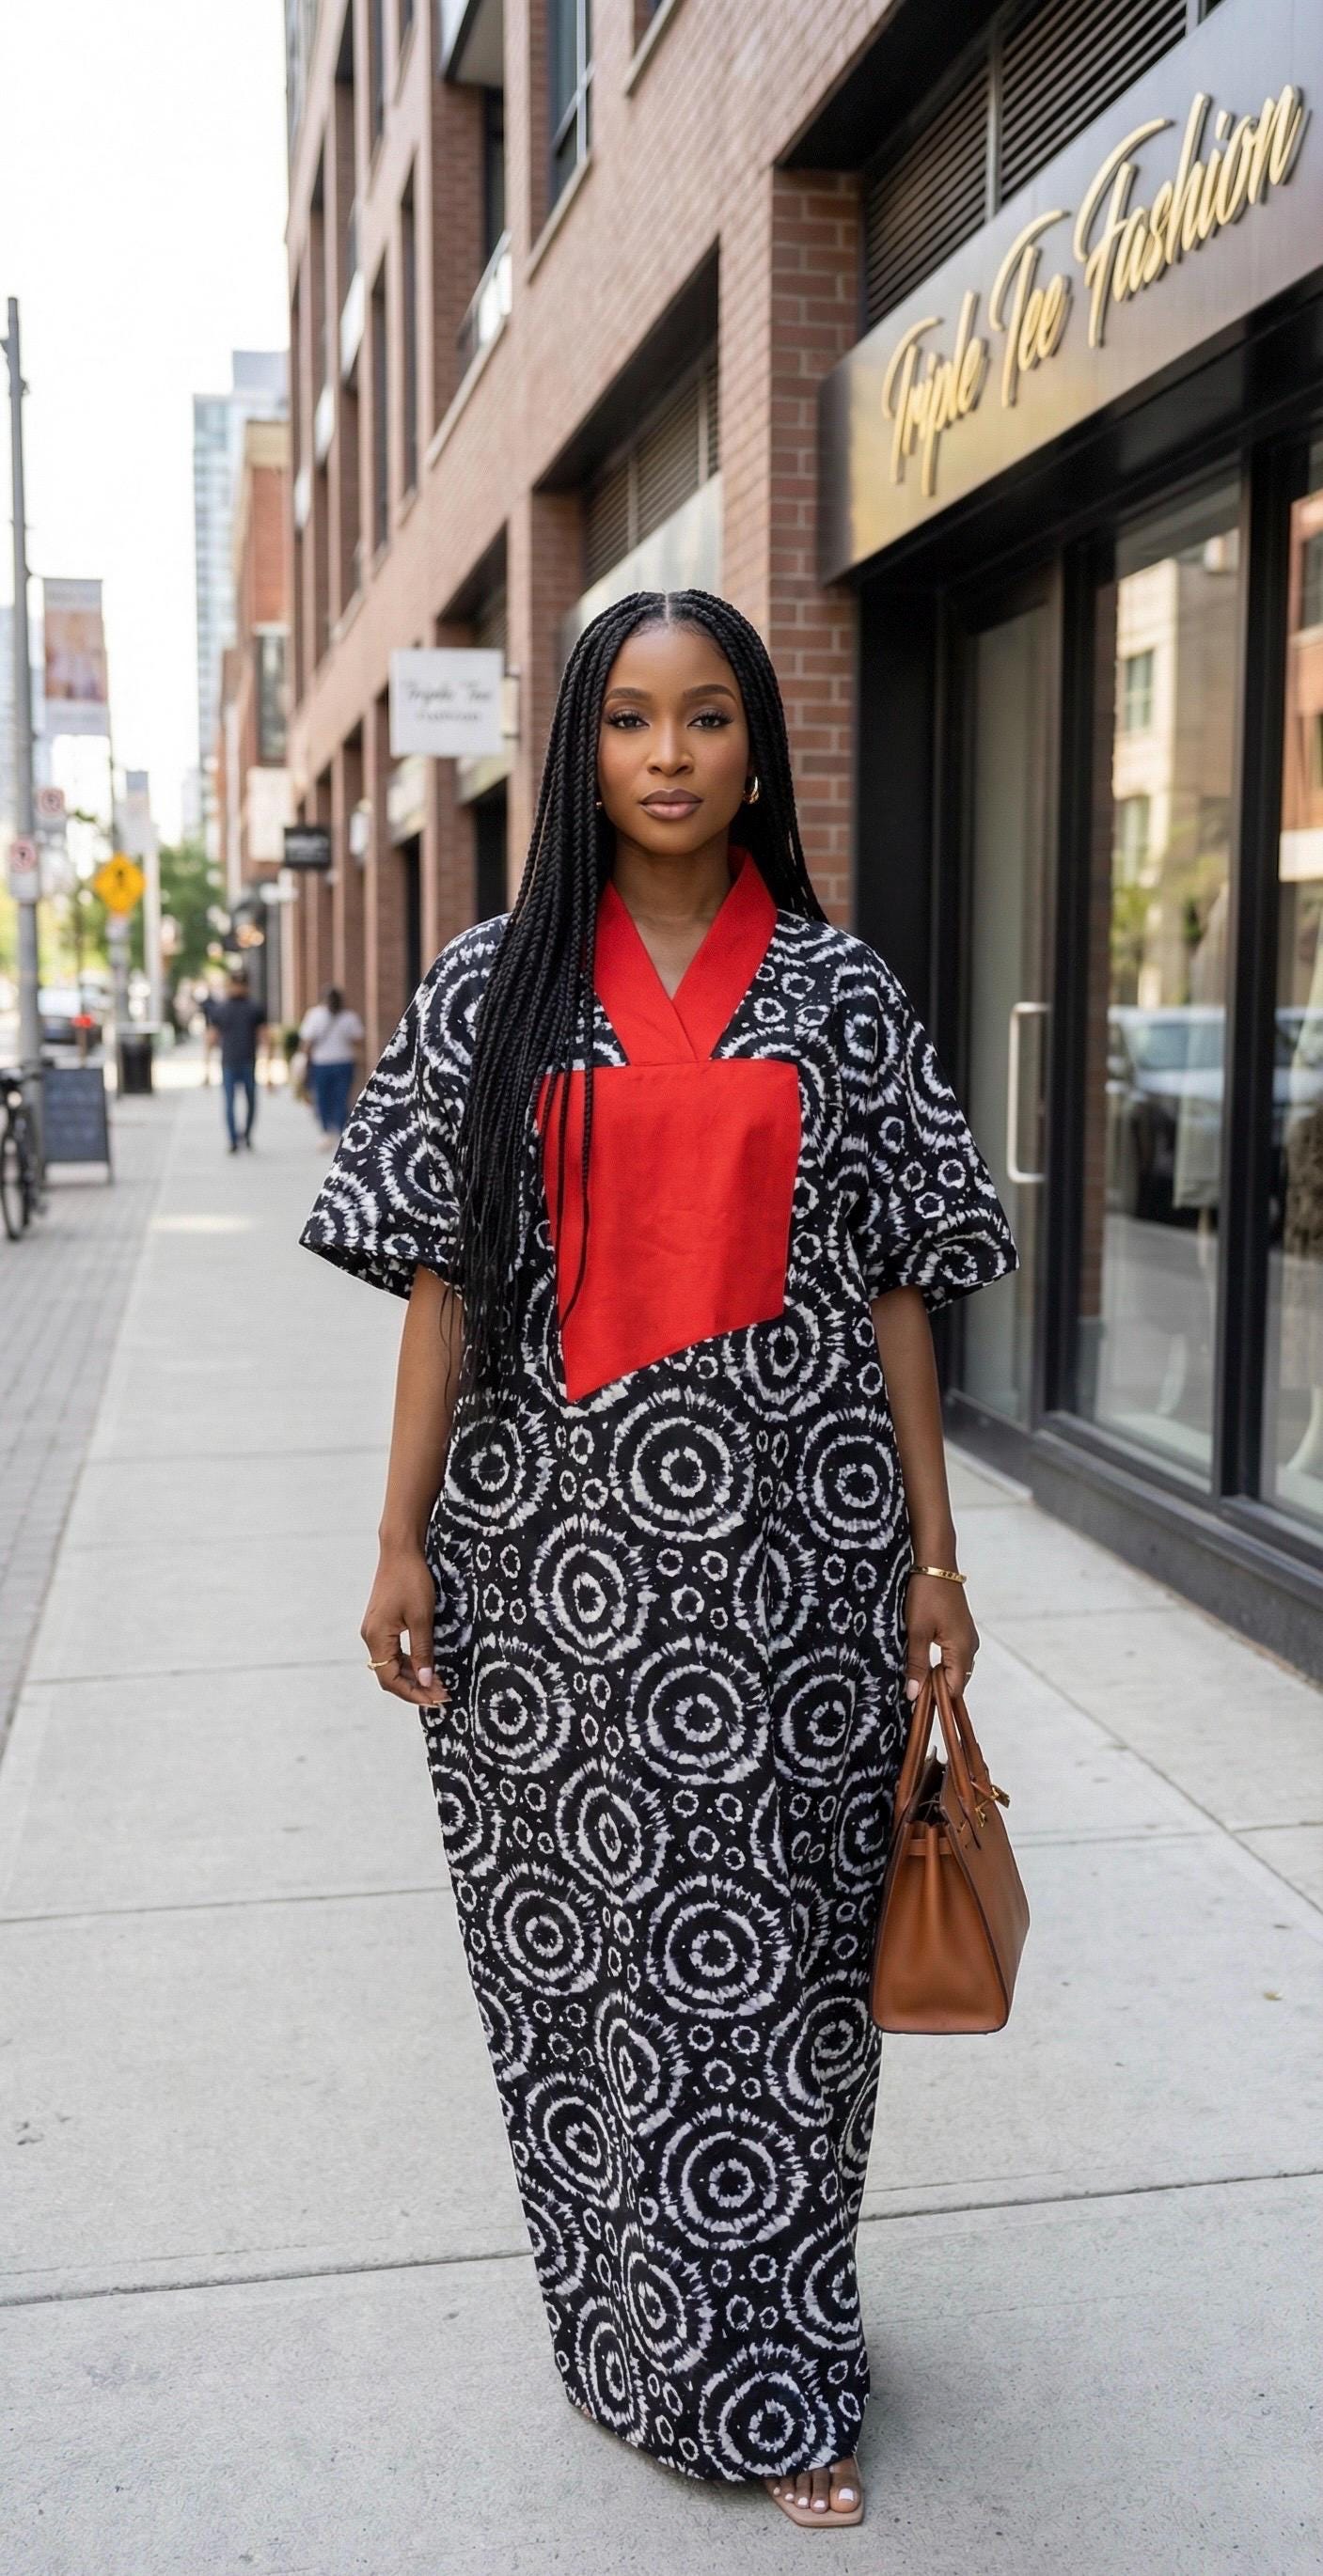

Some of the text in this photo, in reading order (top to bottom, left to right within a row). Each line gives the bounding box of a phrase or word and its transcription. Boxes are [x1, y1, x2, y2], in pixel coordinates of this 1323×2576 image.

[881, 85, 1303, 496] Triple Tee Fashion
